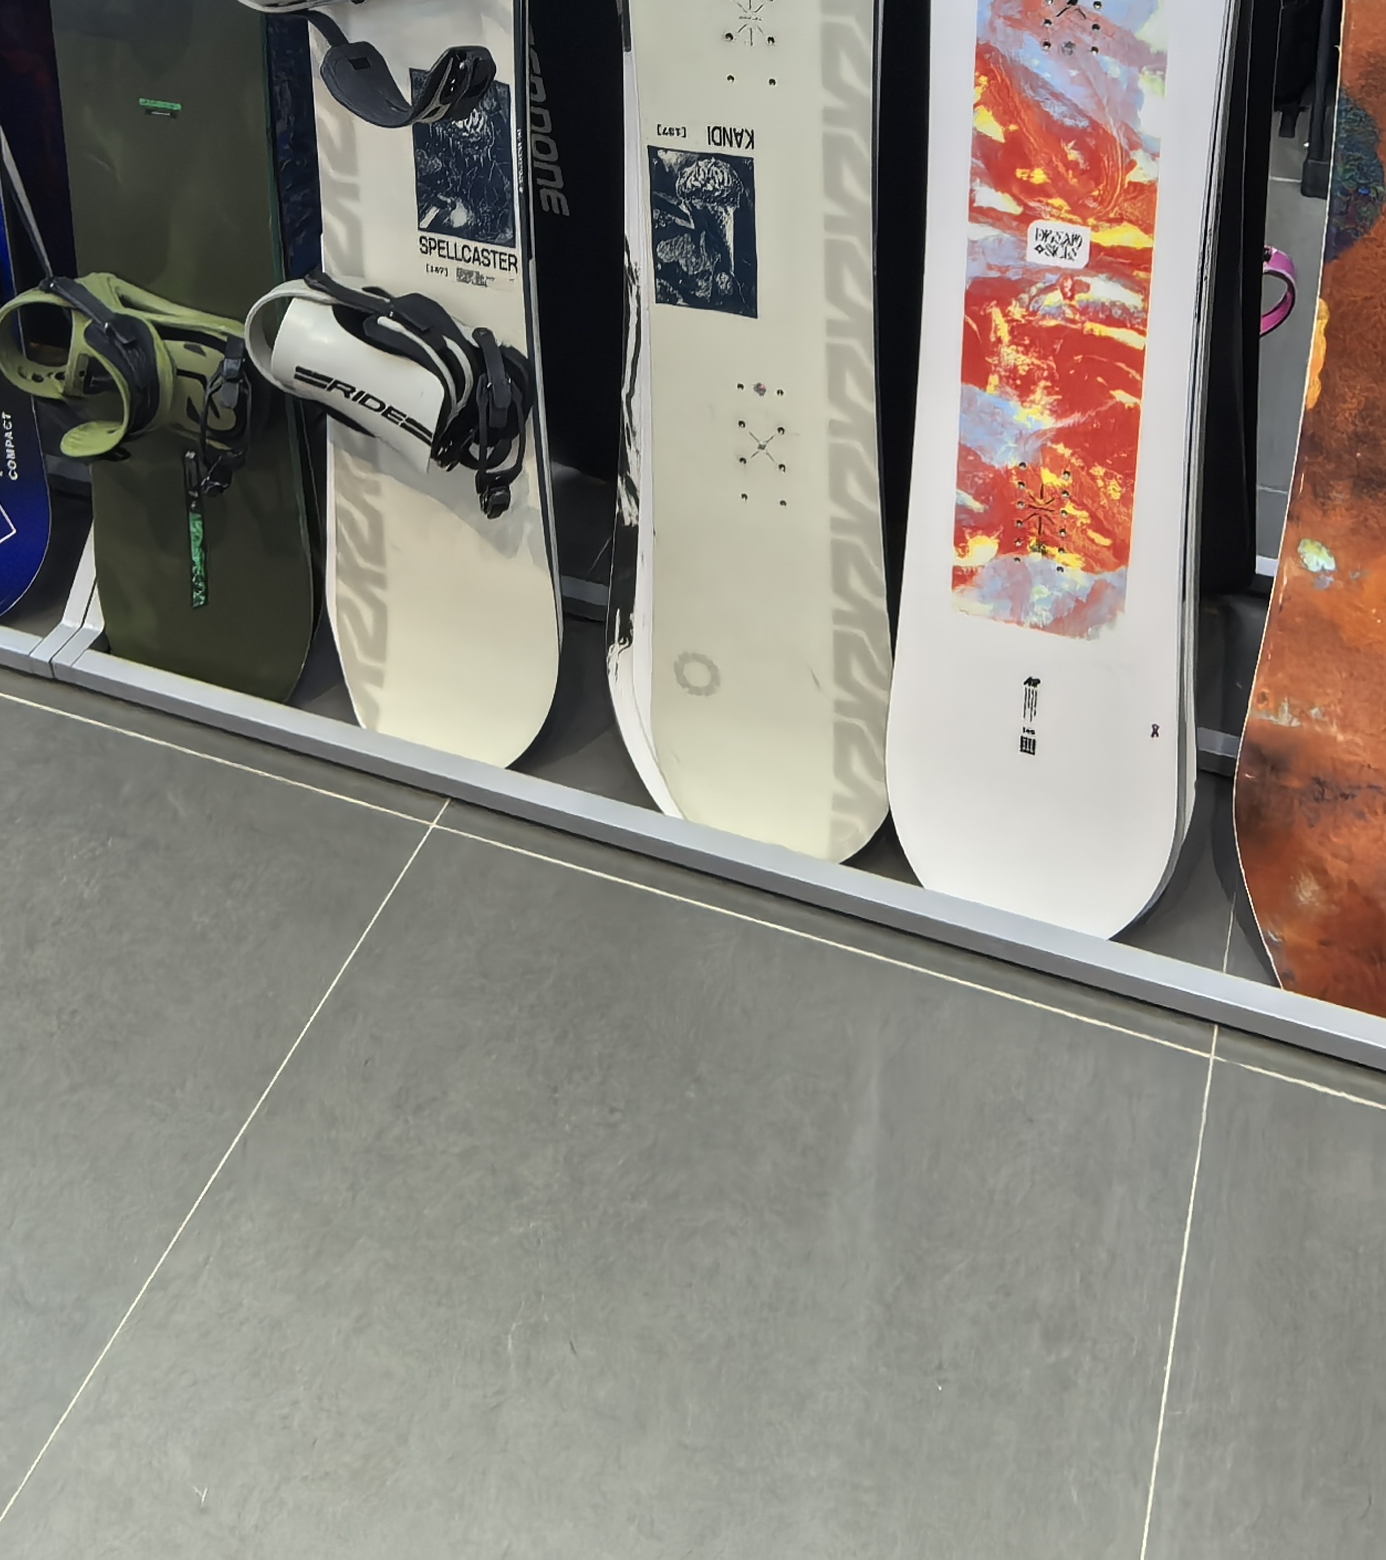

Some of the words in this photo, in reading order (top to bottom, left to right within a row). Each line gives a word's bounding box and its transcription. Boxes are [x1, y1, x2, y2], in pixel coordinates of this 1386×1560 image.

[707, 126, 754, 150] KANDI
[419, 236, 518, 274] SPELLCASTER
[327, 379, 407, 426] RIDE
[1, 411, 18, 481] COMPACT
